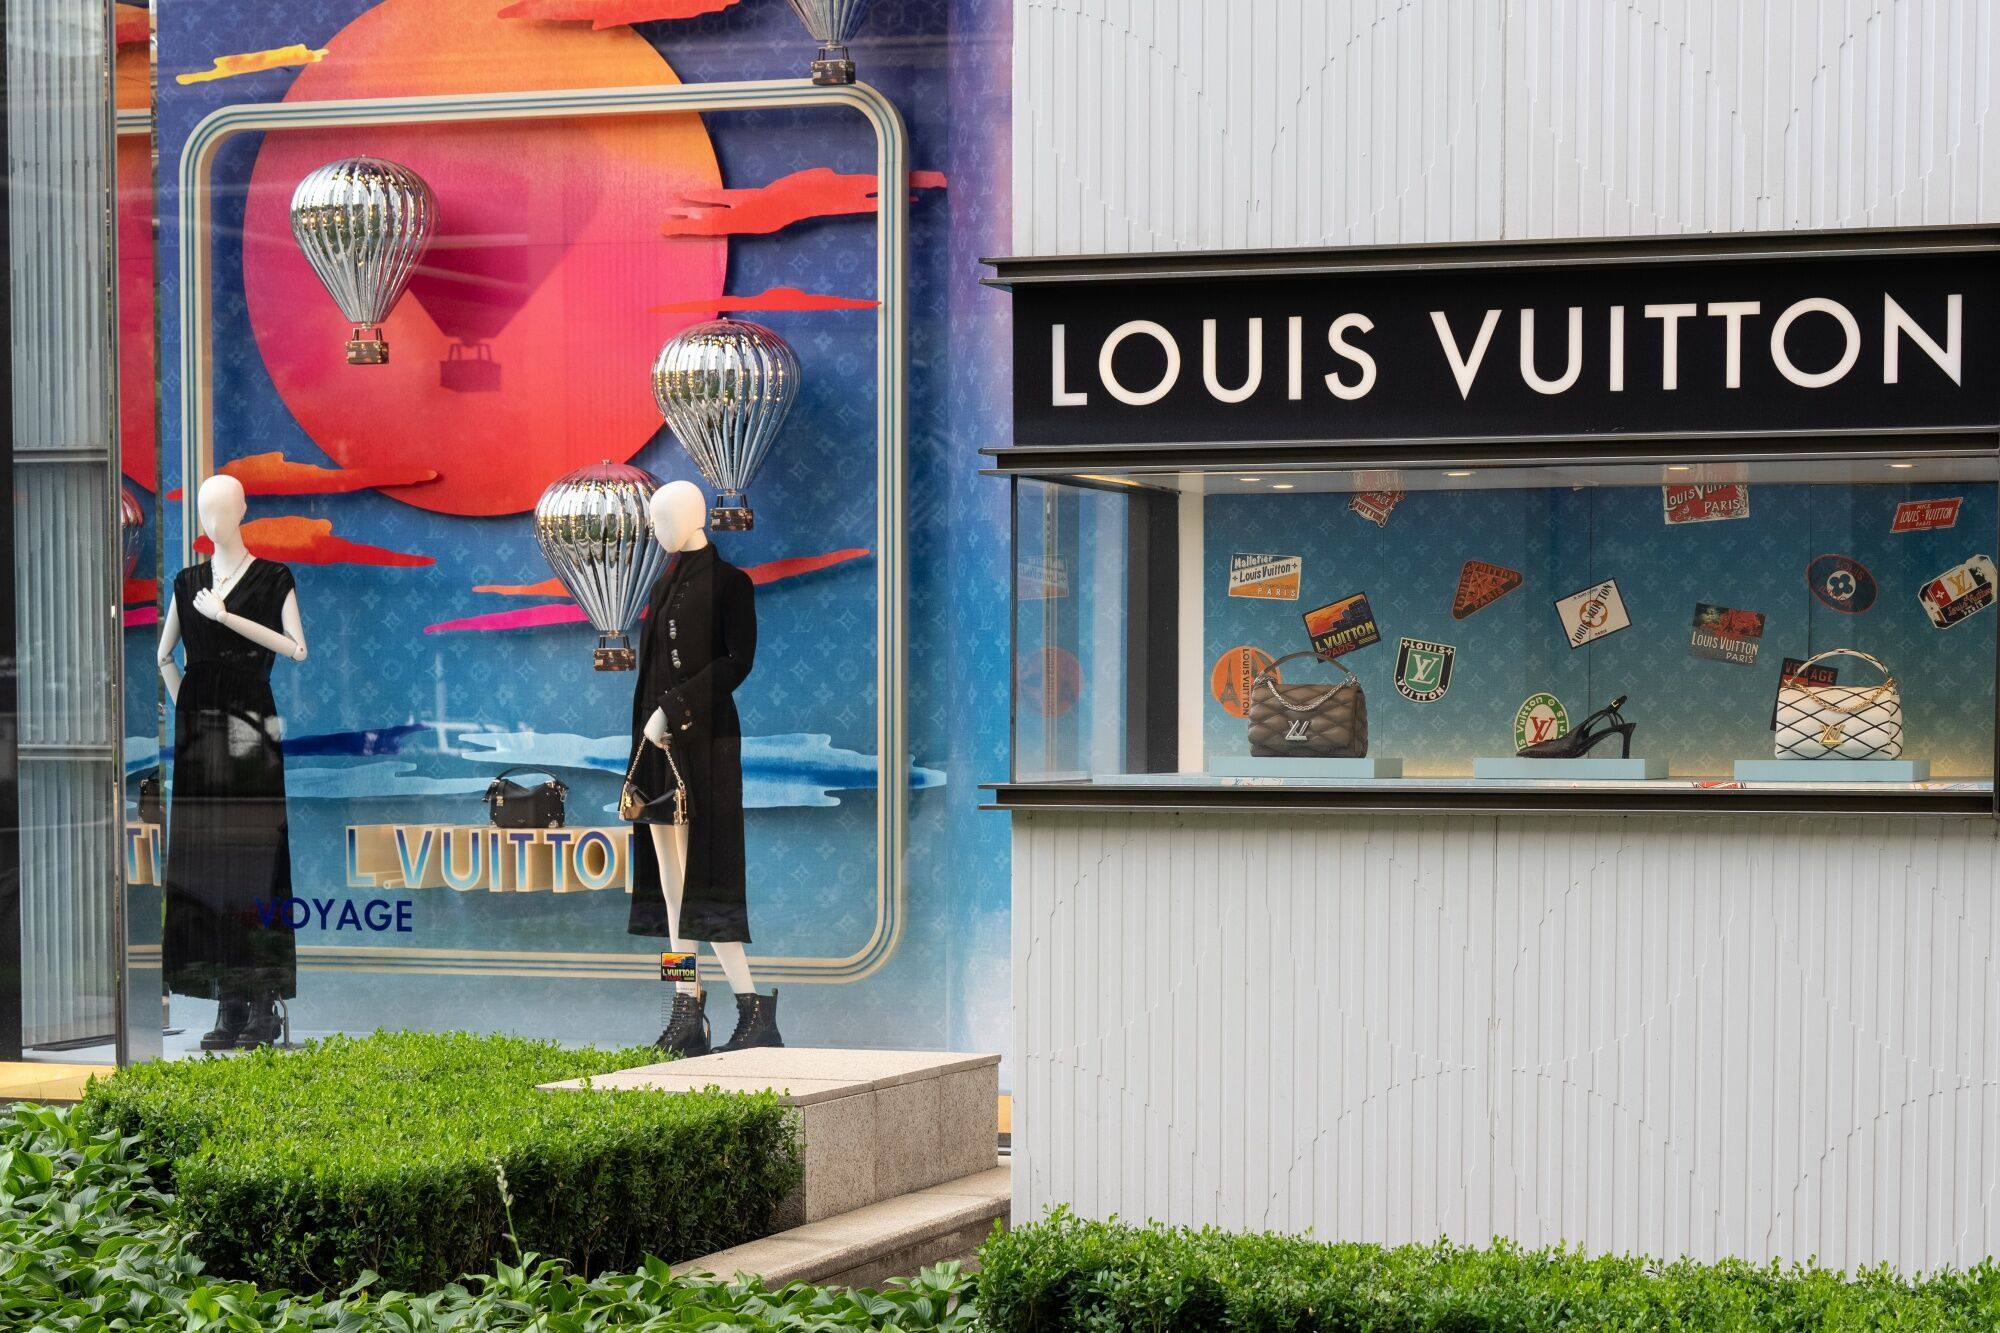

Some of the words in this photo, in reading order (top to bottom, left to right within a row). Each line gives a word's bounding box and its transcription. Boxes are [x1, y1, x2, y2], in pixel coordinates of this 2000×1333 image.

[1053, 312, 1377, 407] LOUIS
[1429, 292, 1963, 402] VUITTON
[1704, 499, 1740, 513] PARIS
[1899, 510, 1920, 524] LOUIS
[1925, 506, 1953, 521] VUITTON
[1239, 567, 1262, 583] Louis
[1262, 563, 1291, 578] Vuitton
[1257, 588, 1296, 597] PARIS
[1585, 584, 1613, 619] VUITTON
[1963, 600, 1984, 616] PARIS
[1315, 621, 1375, 653] L.VUITTON
[1410, 641, 1446, 654] LOUIS
[1692, 630, 1719, 649] LOUIS
[1719, 636, 1759, 655] VUITTON
[1242, 648, 1250, 675] LOUIS
[1725, 652, 1754, 664] PARIS
[1242, 675, 1250, 716] VUITTON
[1397, 678, 1445, 701] VUITTON
[1516, 696, 1543, 734] Vuitton
[255, 896, 413, 933] VOYAGE
